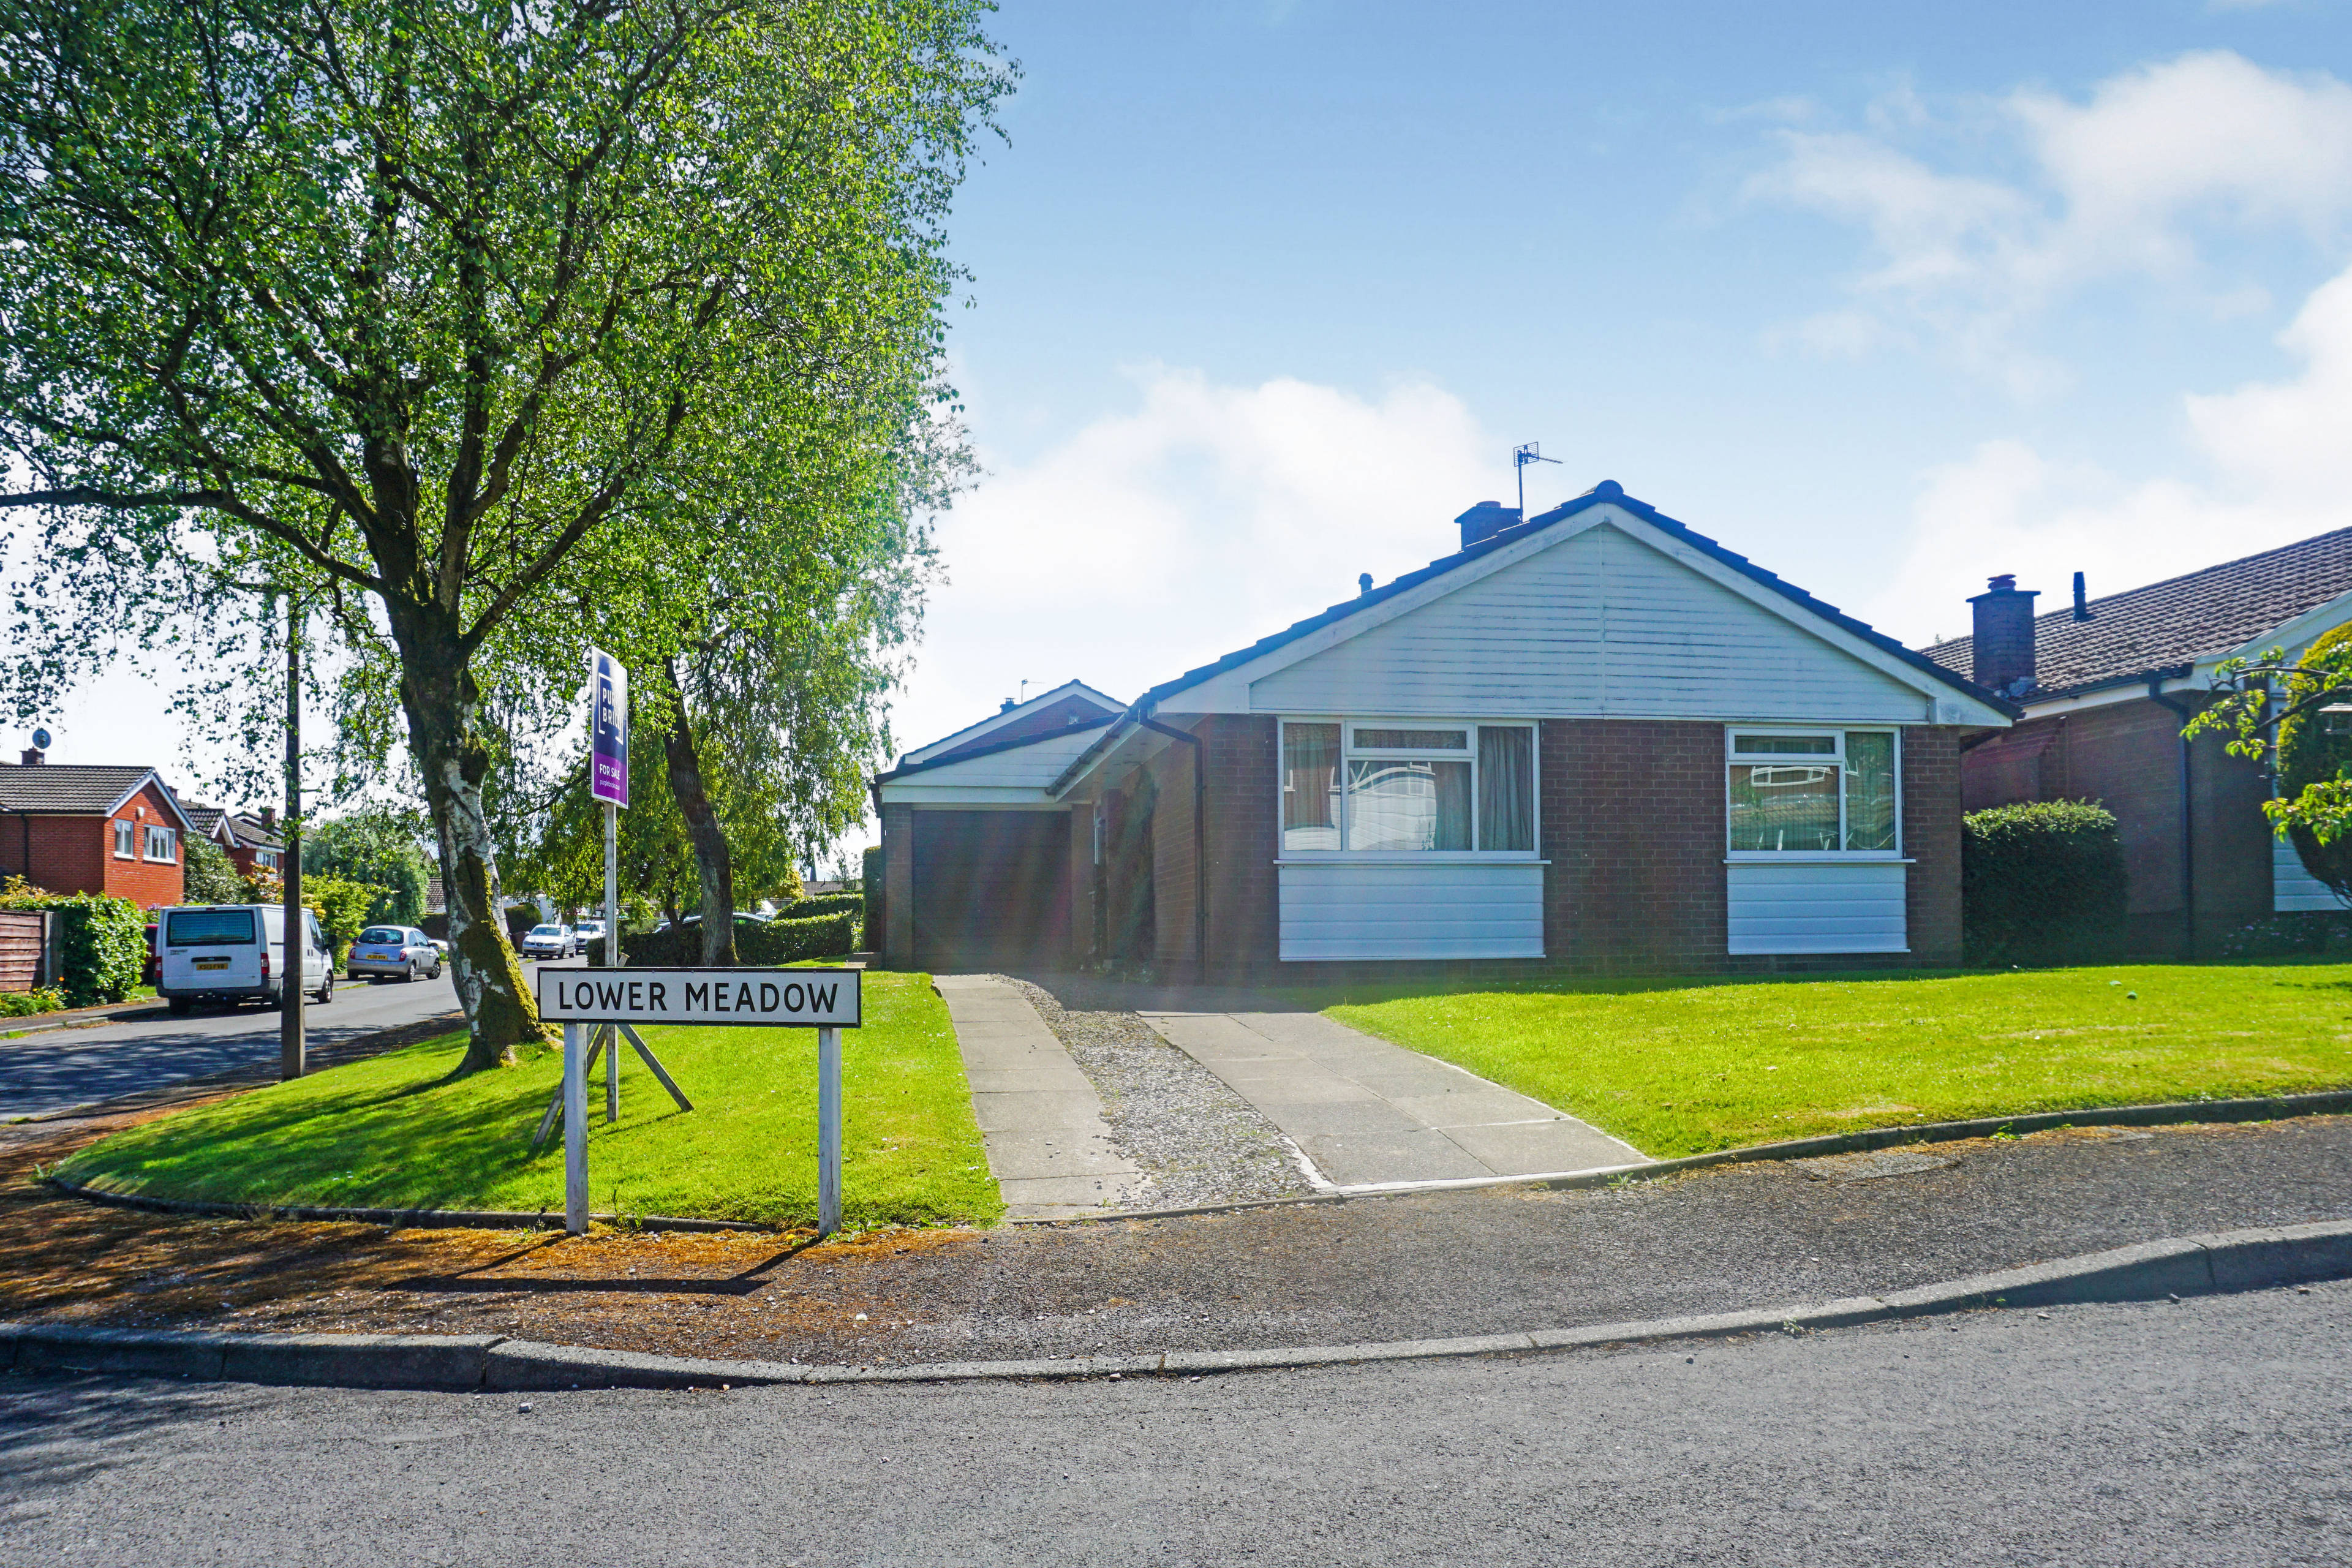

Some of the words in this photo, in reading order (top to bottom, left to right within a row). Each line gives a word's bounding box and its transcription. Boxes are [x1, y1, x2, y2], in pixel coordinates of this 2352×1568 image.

[603, 687, 622, 712] PUR
[599, 763, 611, 777] FOR
[611, 767, 620, 780] SALE
[559, 981, 667, 1011] LOWER
[685, 982, 838, 1013] MEADOW
